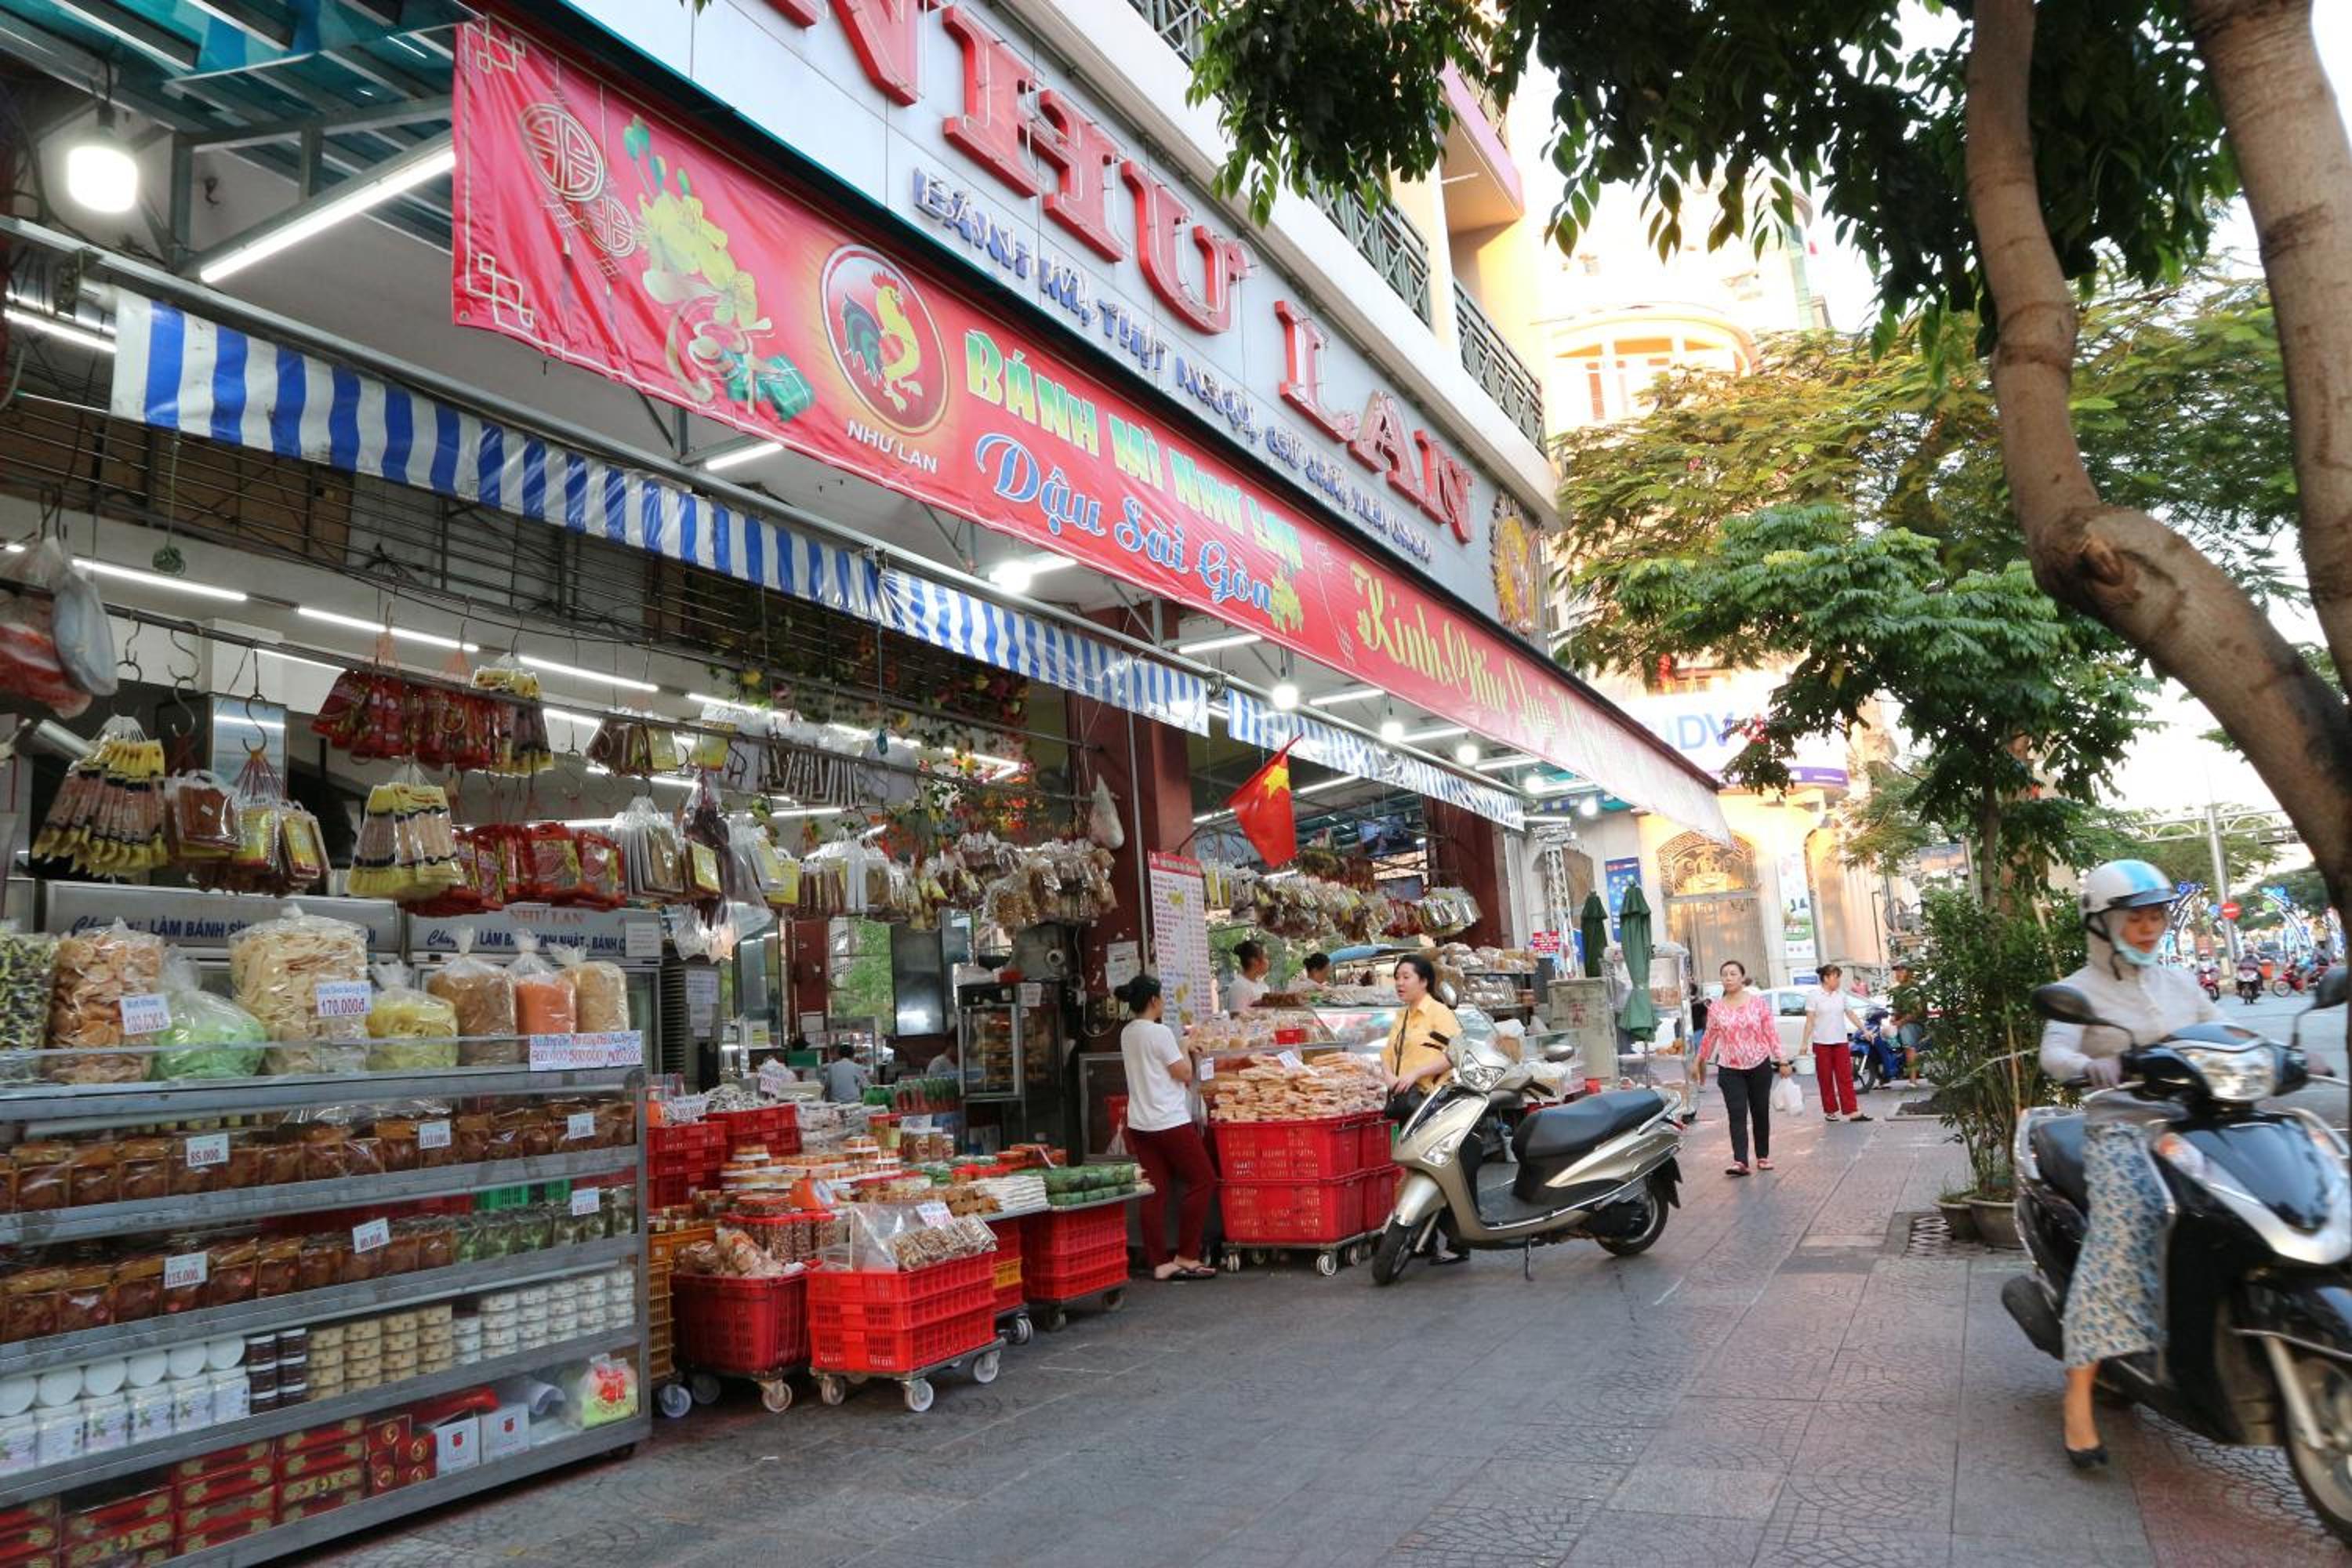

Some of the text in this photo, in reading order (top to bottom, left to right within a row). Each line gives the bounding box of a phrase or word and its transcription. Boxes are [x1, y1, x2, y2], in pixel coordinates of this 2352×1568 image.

[847, 419, 938, 474] NHƯ LAN
[964, 328, 1100, 458] BÁNH
[1108, 412, 1164, 491] MÌ
[1274, 300, 1475, 546] LAN
[975, 432, 1272, 615] Dậu Sài Gòn
[150, 916, 181, 937] LÀM
[186, 917, 225, 938] BÁNH
[592, 934, 617, 950] BÁNH
